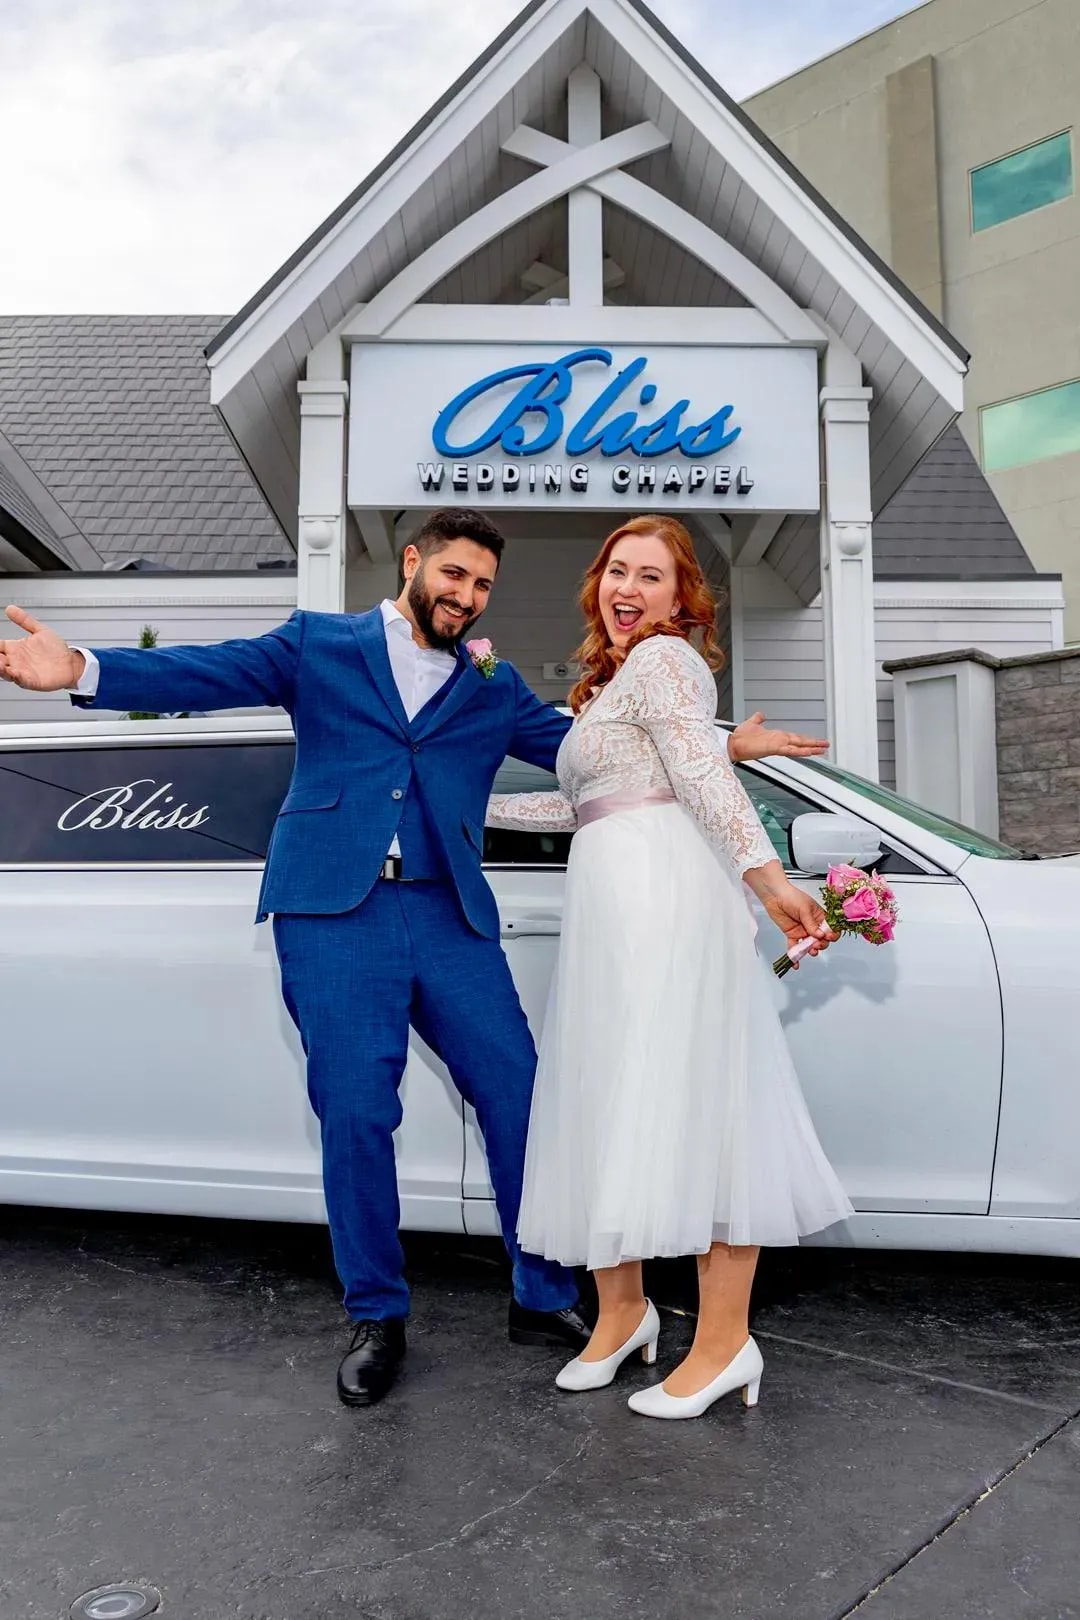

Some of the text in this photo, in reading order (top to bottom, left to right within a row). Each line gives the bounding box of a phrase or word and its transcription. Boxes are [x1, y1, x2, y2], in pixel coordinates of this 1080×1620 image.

[432, 348, 742, 458] Bliss
[417, 462, 755, 494] WEDDING CHAPEL
[57, 779, 210, 831] Bliss
